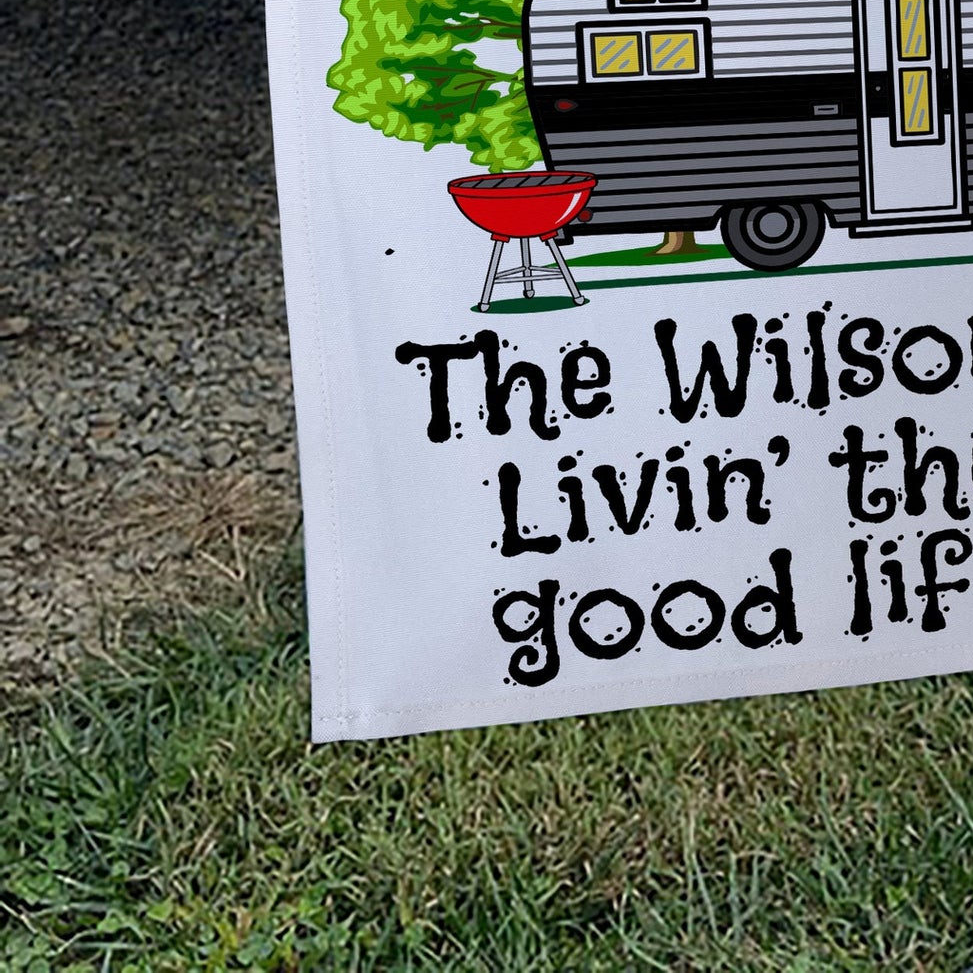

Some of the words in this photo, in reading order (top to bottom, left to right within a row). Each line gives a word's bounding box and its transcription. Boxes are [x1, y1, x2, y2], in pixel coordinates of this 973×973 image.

[395, 330, 611, 443] The
[498, 435, 790, 557] Livin'
[492, 548, 803, 687] good
